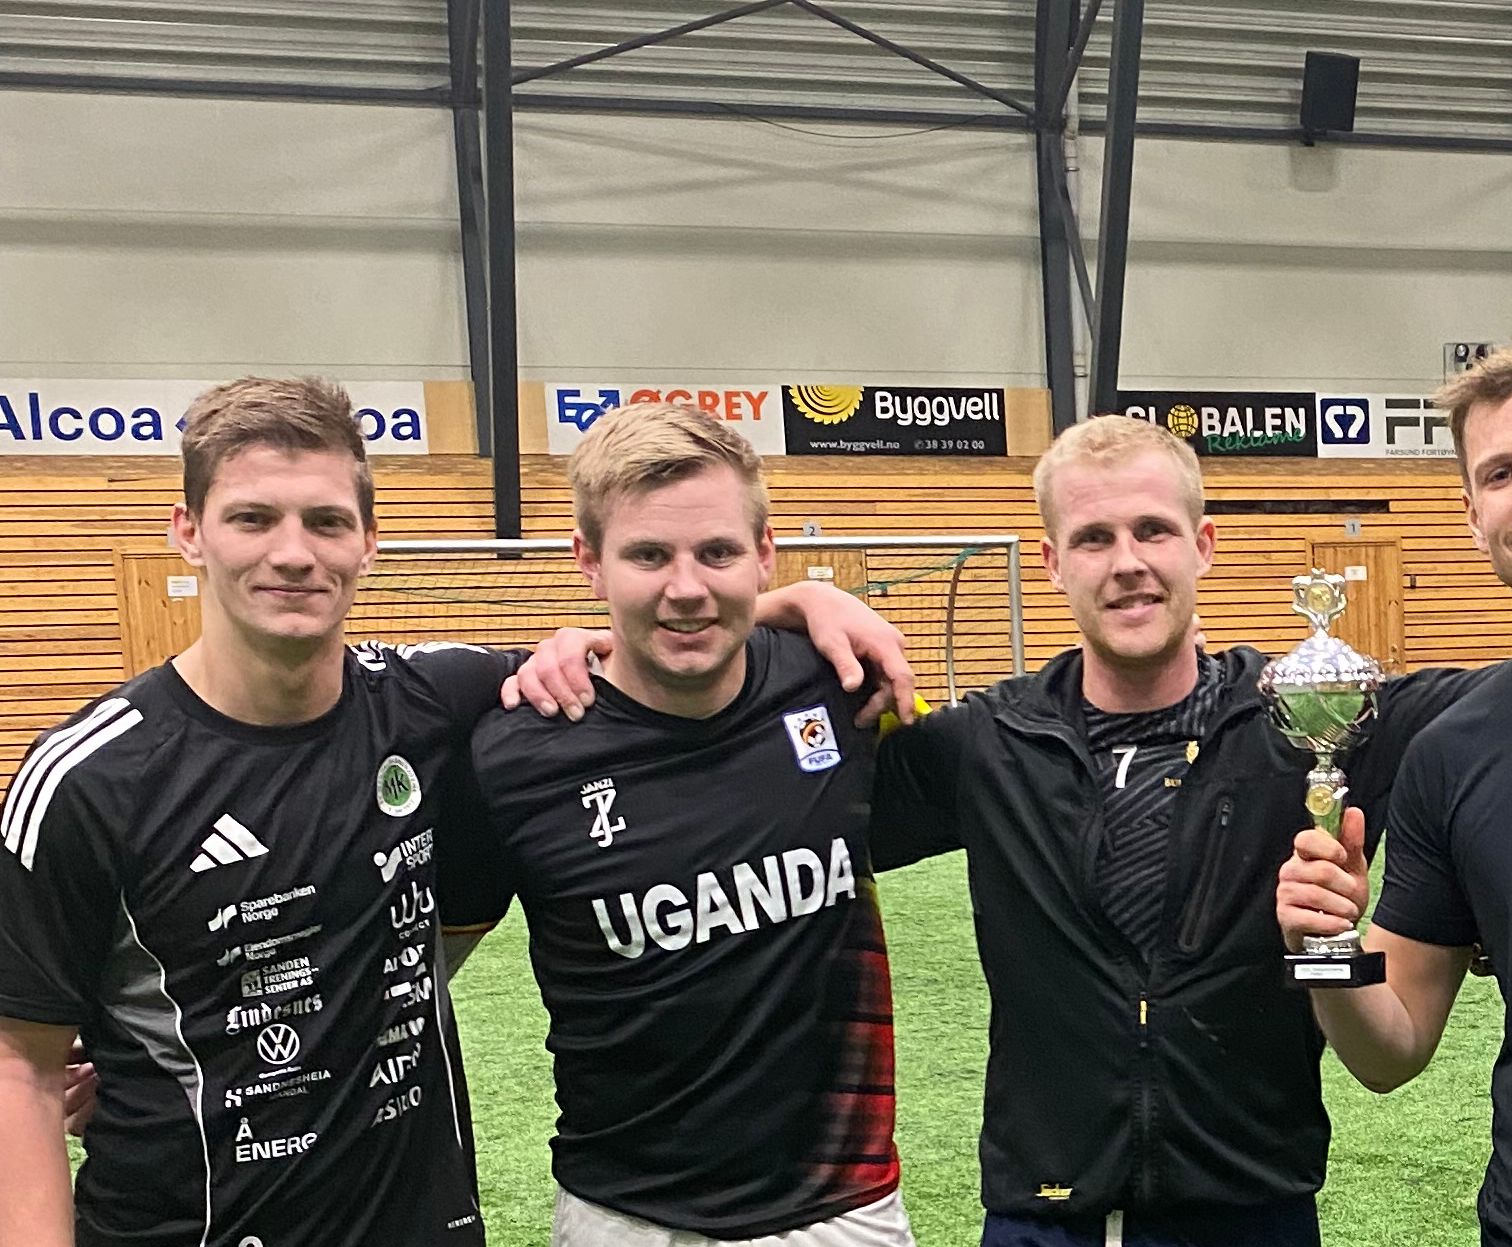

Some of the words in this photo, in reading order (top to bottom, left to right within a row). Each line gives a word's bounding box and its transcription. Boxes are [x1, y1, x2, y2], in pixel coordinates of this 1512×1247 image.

[0, 392, 163, 441] Alcoa
[874, 391, 1000, 426] Byggvell
[810, 440, 900, 451] www.byggvell.no
[925, 440, 938, 449] 38
[941, 440, 953, 449] 39
[957, 440, 969, 449] 02
[972, 440, 985, 449] 00
[1207, 428, 1305, 453] Reklame
[1112, 744, 1137, 788] 7
[580, 778, 614, 794] JANZI
[400, 827, 433, 857] INTER
[240, 885, 316, 912] Sparebanken
[592, 837, 856, 959] UGANDA
[241, 907, 279, 923] Norge
[262, 957, 310, 975] SANDEN
[264, 980, 299, 994] SENTER
[300, 976, 313, 987] AS
[225, 994, 324, 1035] Lindesnes
[235, 1117, 253, 1142] Å
